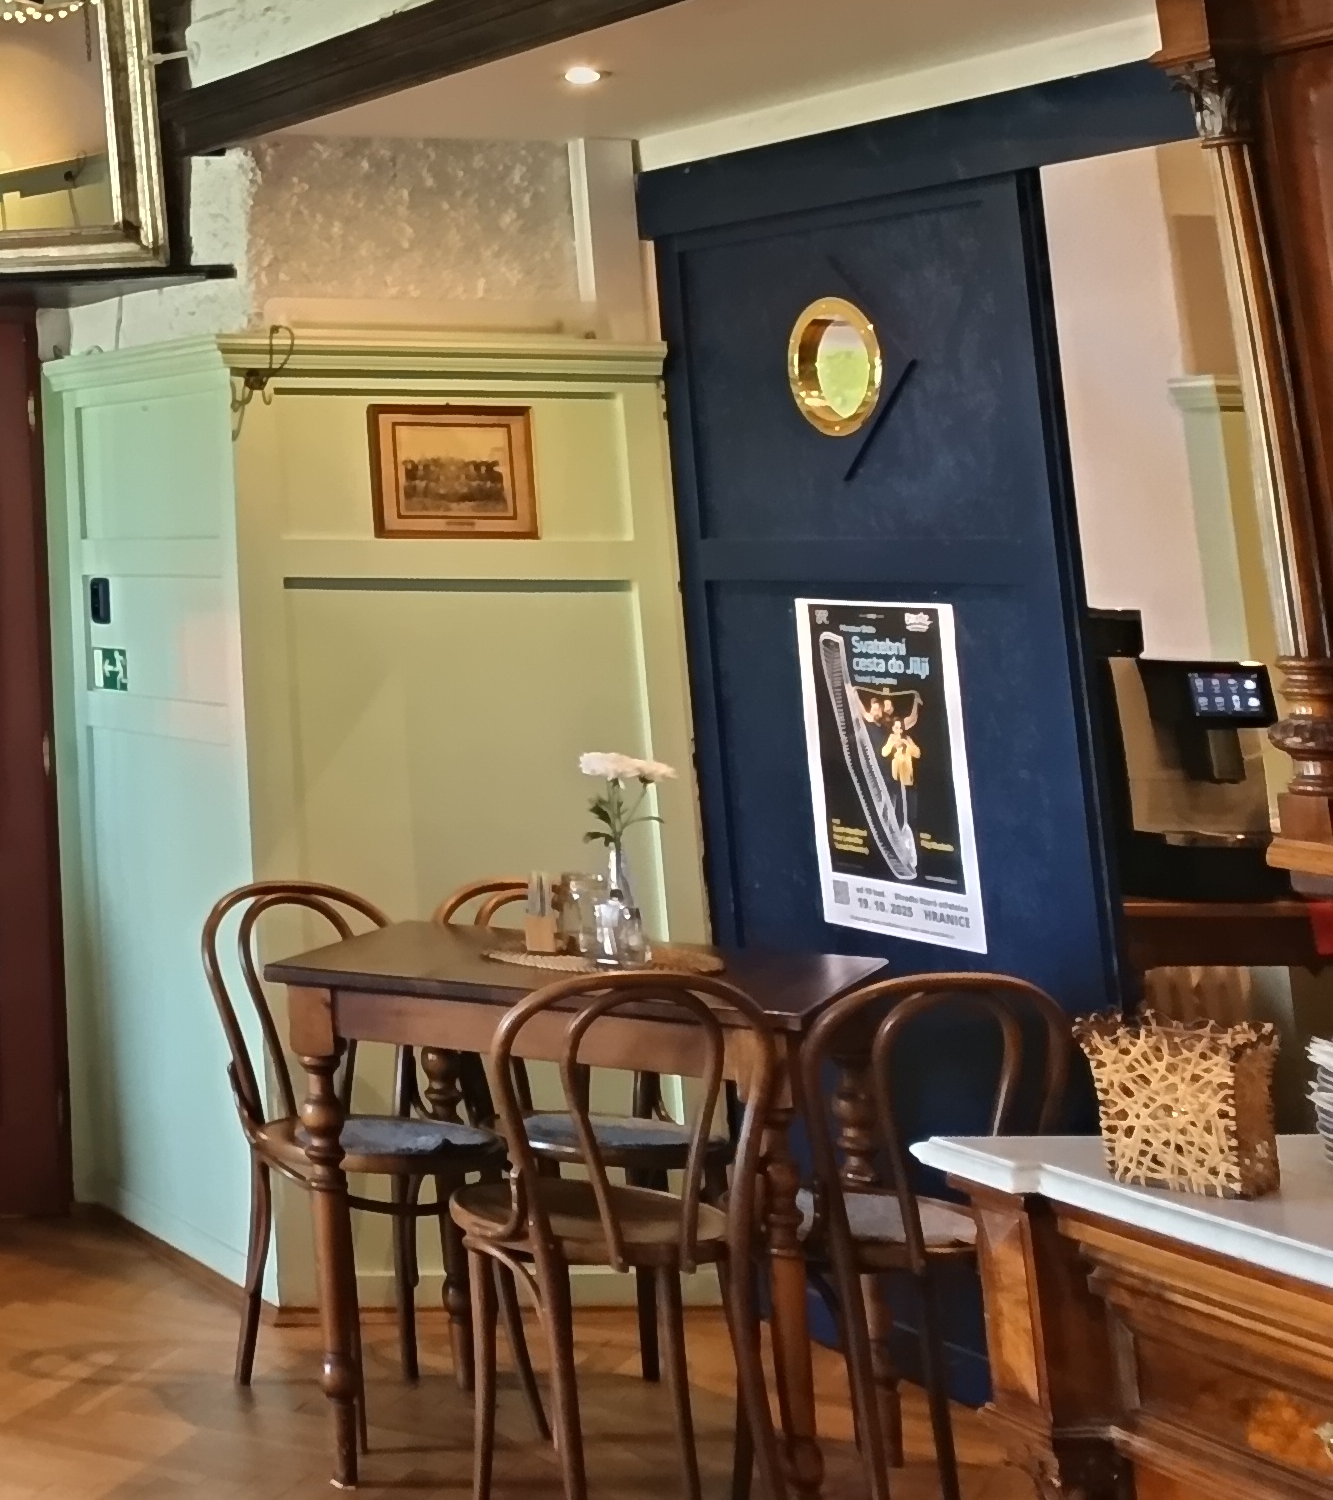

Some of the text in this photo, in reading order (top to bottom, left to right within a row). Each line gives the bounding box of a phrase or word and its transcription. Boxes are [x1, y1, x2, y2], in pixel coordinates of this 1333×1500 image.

[851, 635, 907, 656] Svatební
[852, 656, 886, 673] cesta
[888, 656, 905, 674] do
[890, 903, 914, 918] 2025
[923, 909, 971, 929] HRANICE
